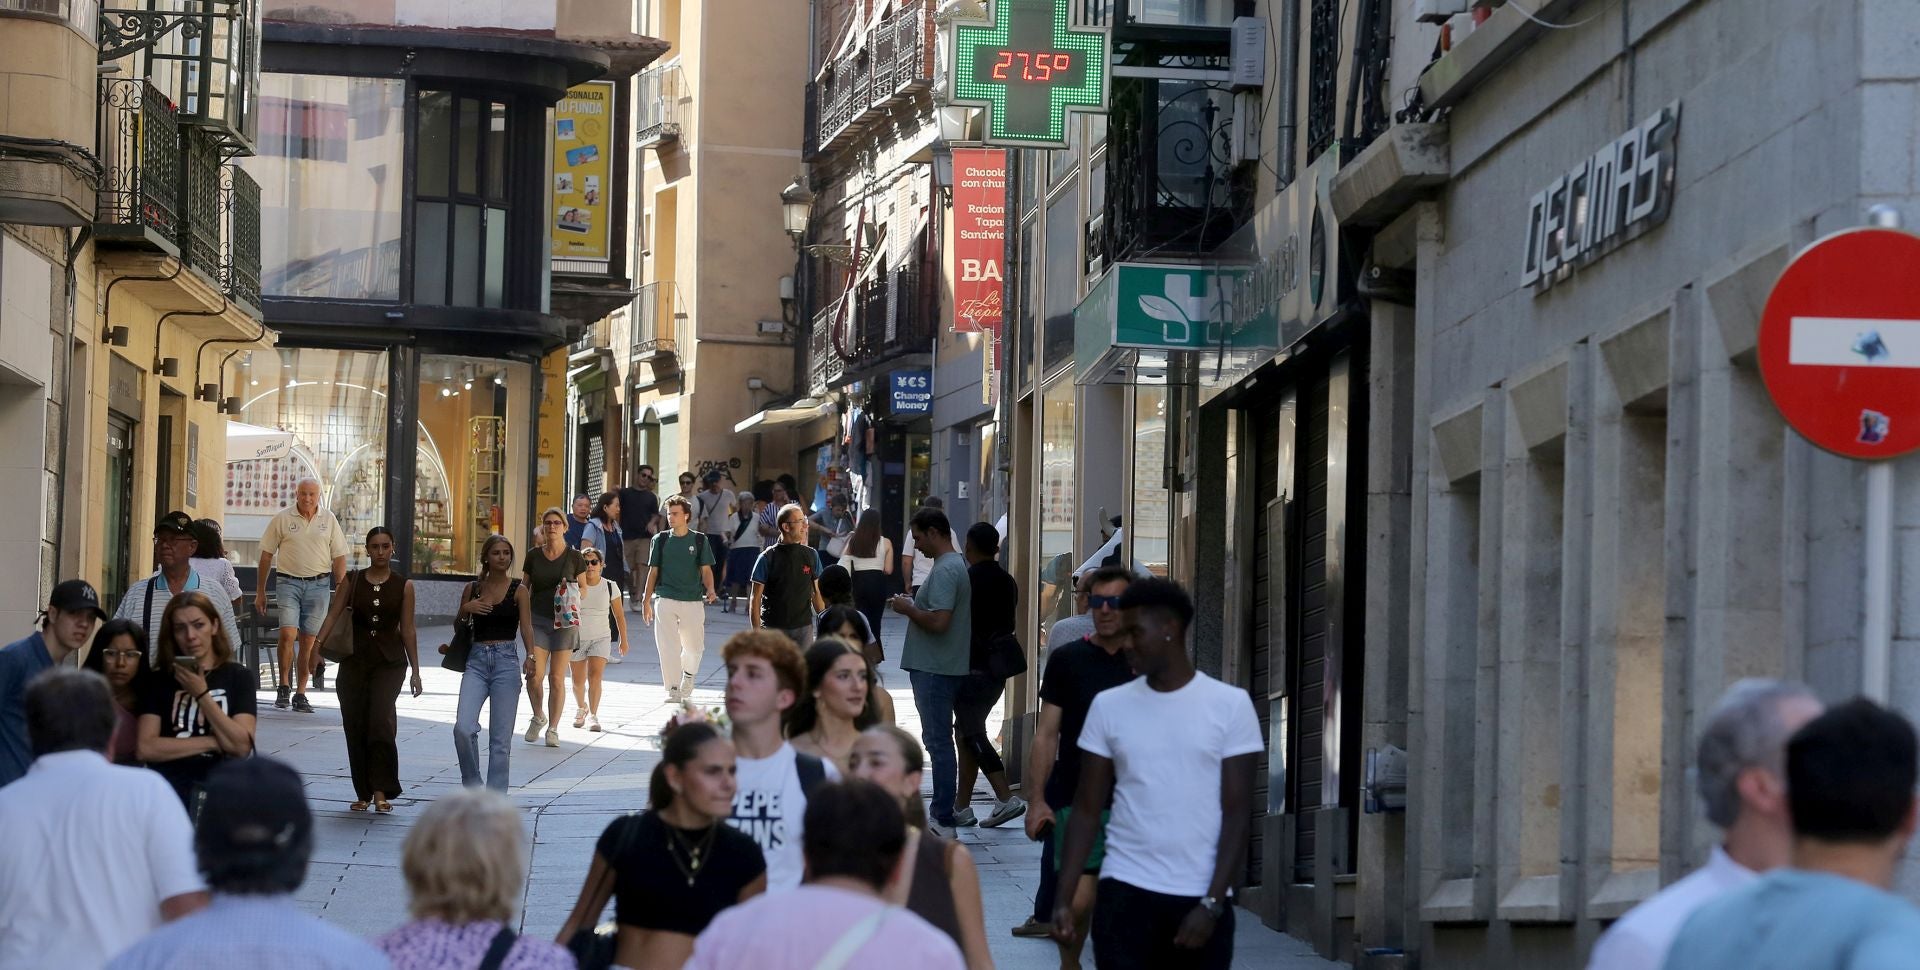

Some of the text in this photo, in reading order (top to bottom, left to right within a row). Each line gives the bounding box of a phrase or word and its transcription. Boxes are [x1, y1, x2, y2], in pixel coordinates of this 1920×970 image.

[570, 101, 603, 115] FUNDA
[961, 180, 980, 188] con
[1520, 106, 1667, 288] DECIMAS
[968, 204, 1005, 214] Racion
[961, 258, 1003, 282] BA
[893, 391, 931, 401] Change
[896, 401, 928, 411] Money
[731, 790, 783, 817] EPE
